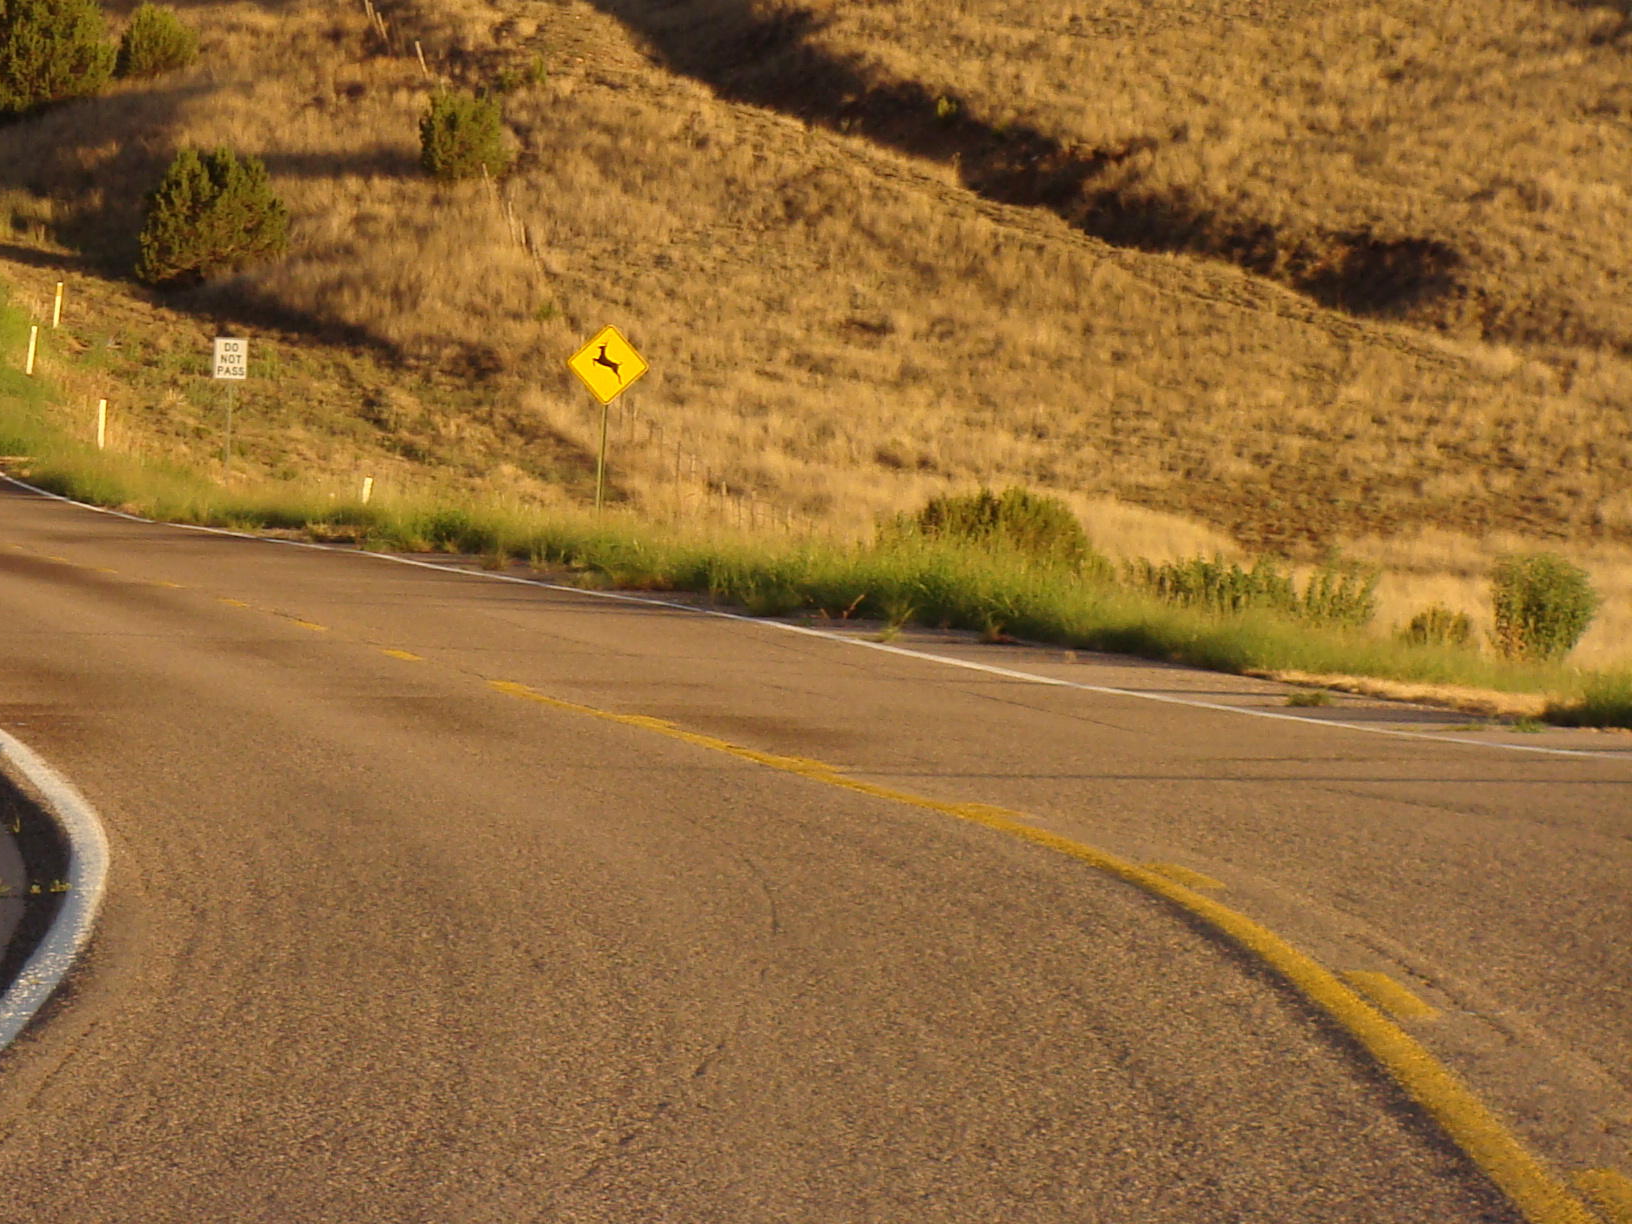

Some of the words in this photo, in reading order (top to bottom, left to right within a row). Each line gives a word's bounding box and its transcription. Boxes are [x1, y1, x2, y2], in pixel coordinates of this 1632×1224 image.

[224, 342, 239, 352] DO
[220, 354, 242, 364] NOT
[217, 366, 245, 376] PASS
